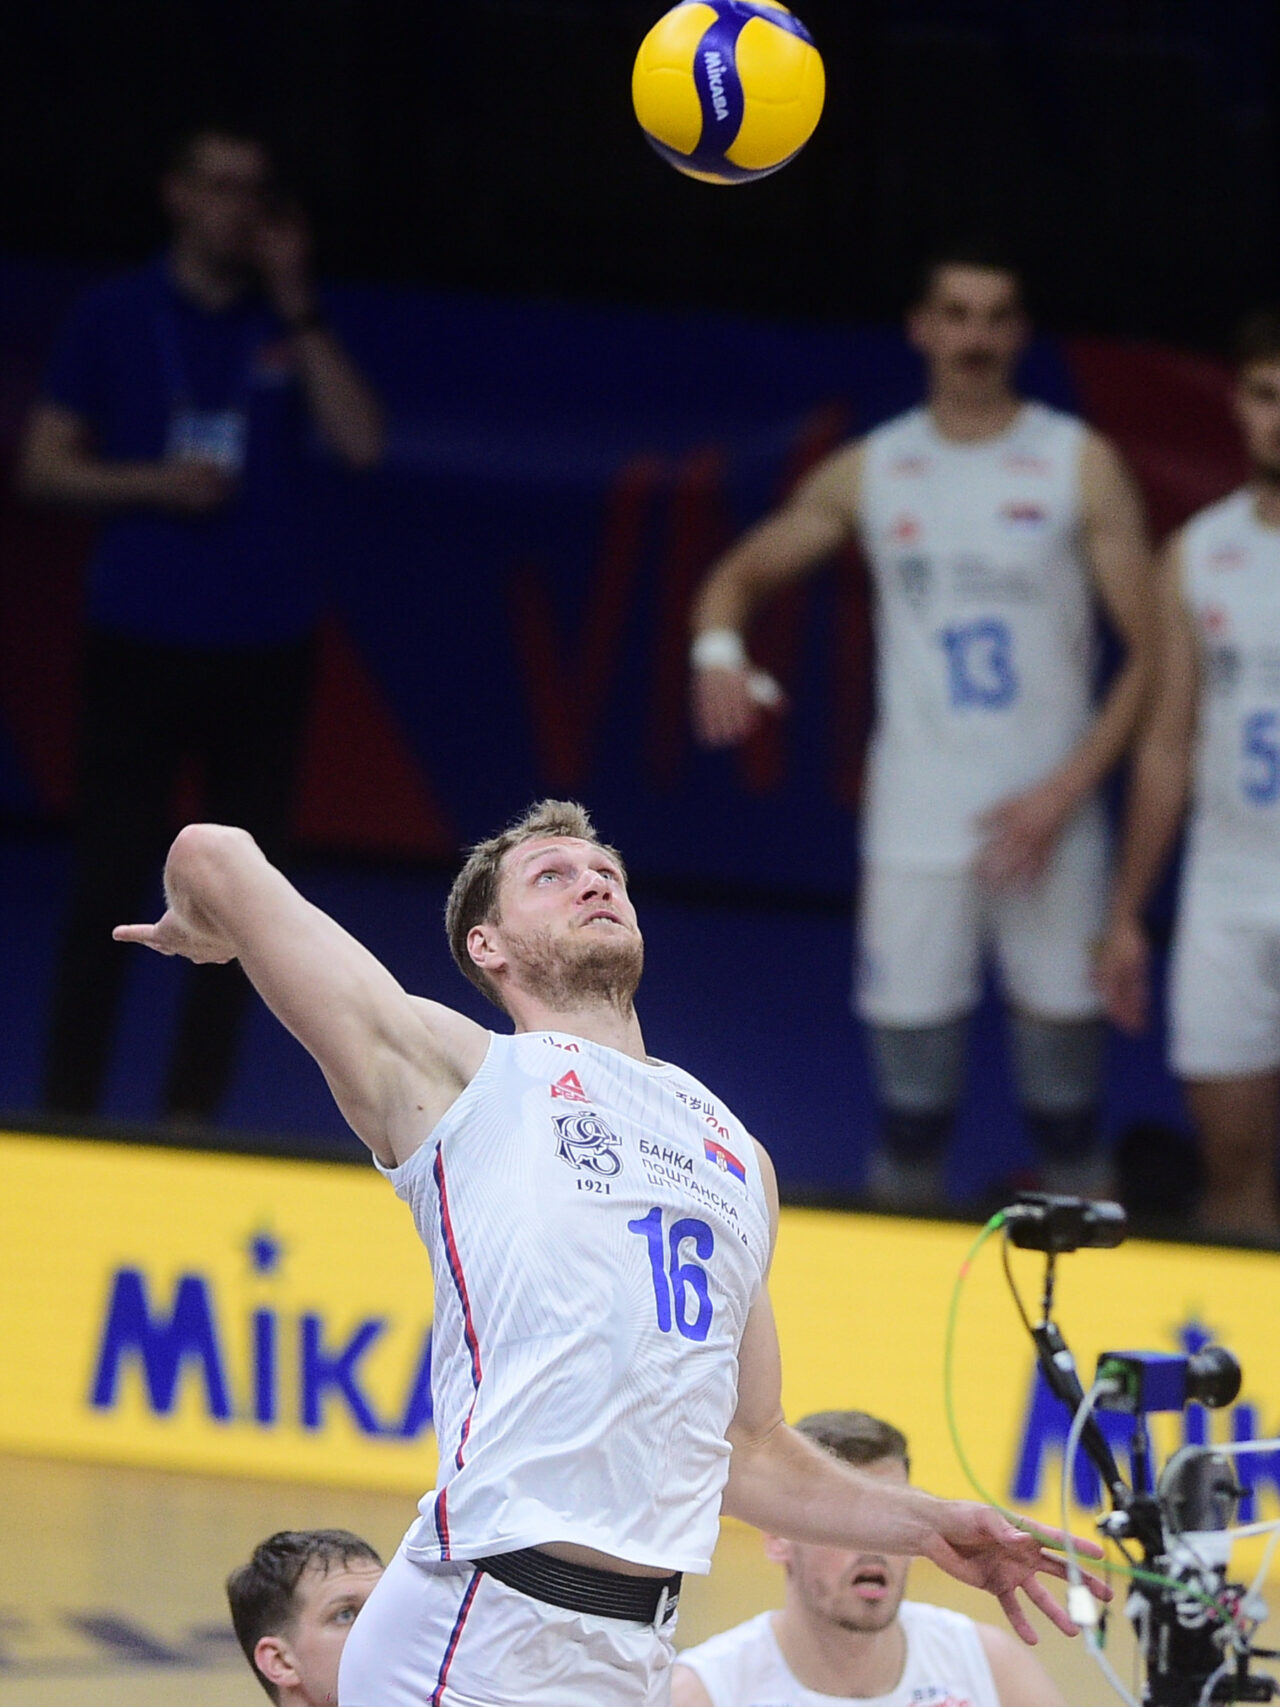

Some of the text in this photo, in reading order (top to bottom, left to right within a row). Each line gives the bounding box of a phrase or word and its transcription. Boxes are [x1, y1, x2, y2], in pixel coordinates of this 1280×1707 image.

[940, 617, 1018, 710] 13
[576, 1178, 611, 1195] 1921
[639, 1139, 694, 1174] БАНКА
[642, 1158, 739, 1221] ПОШТАНСКА
[627, 1206, 714, 1342] 16
